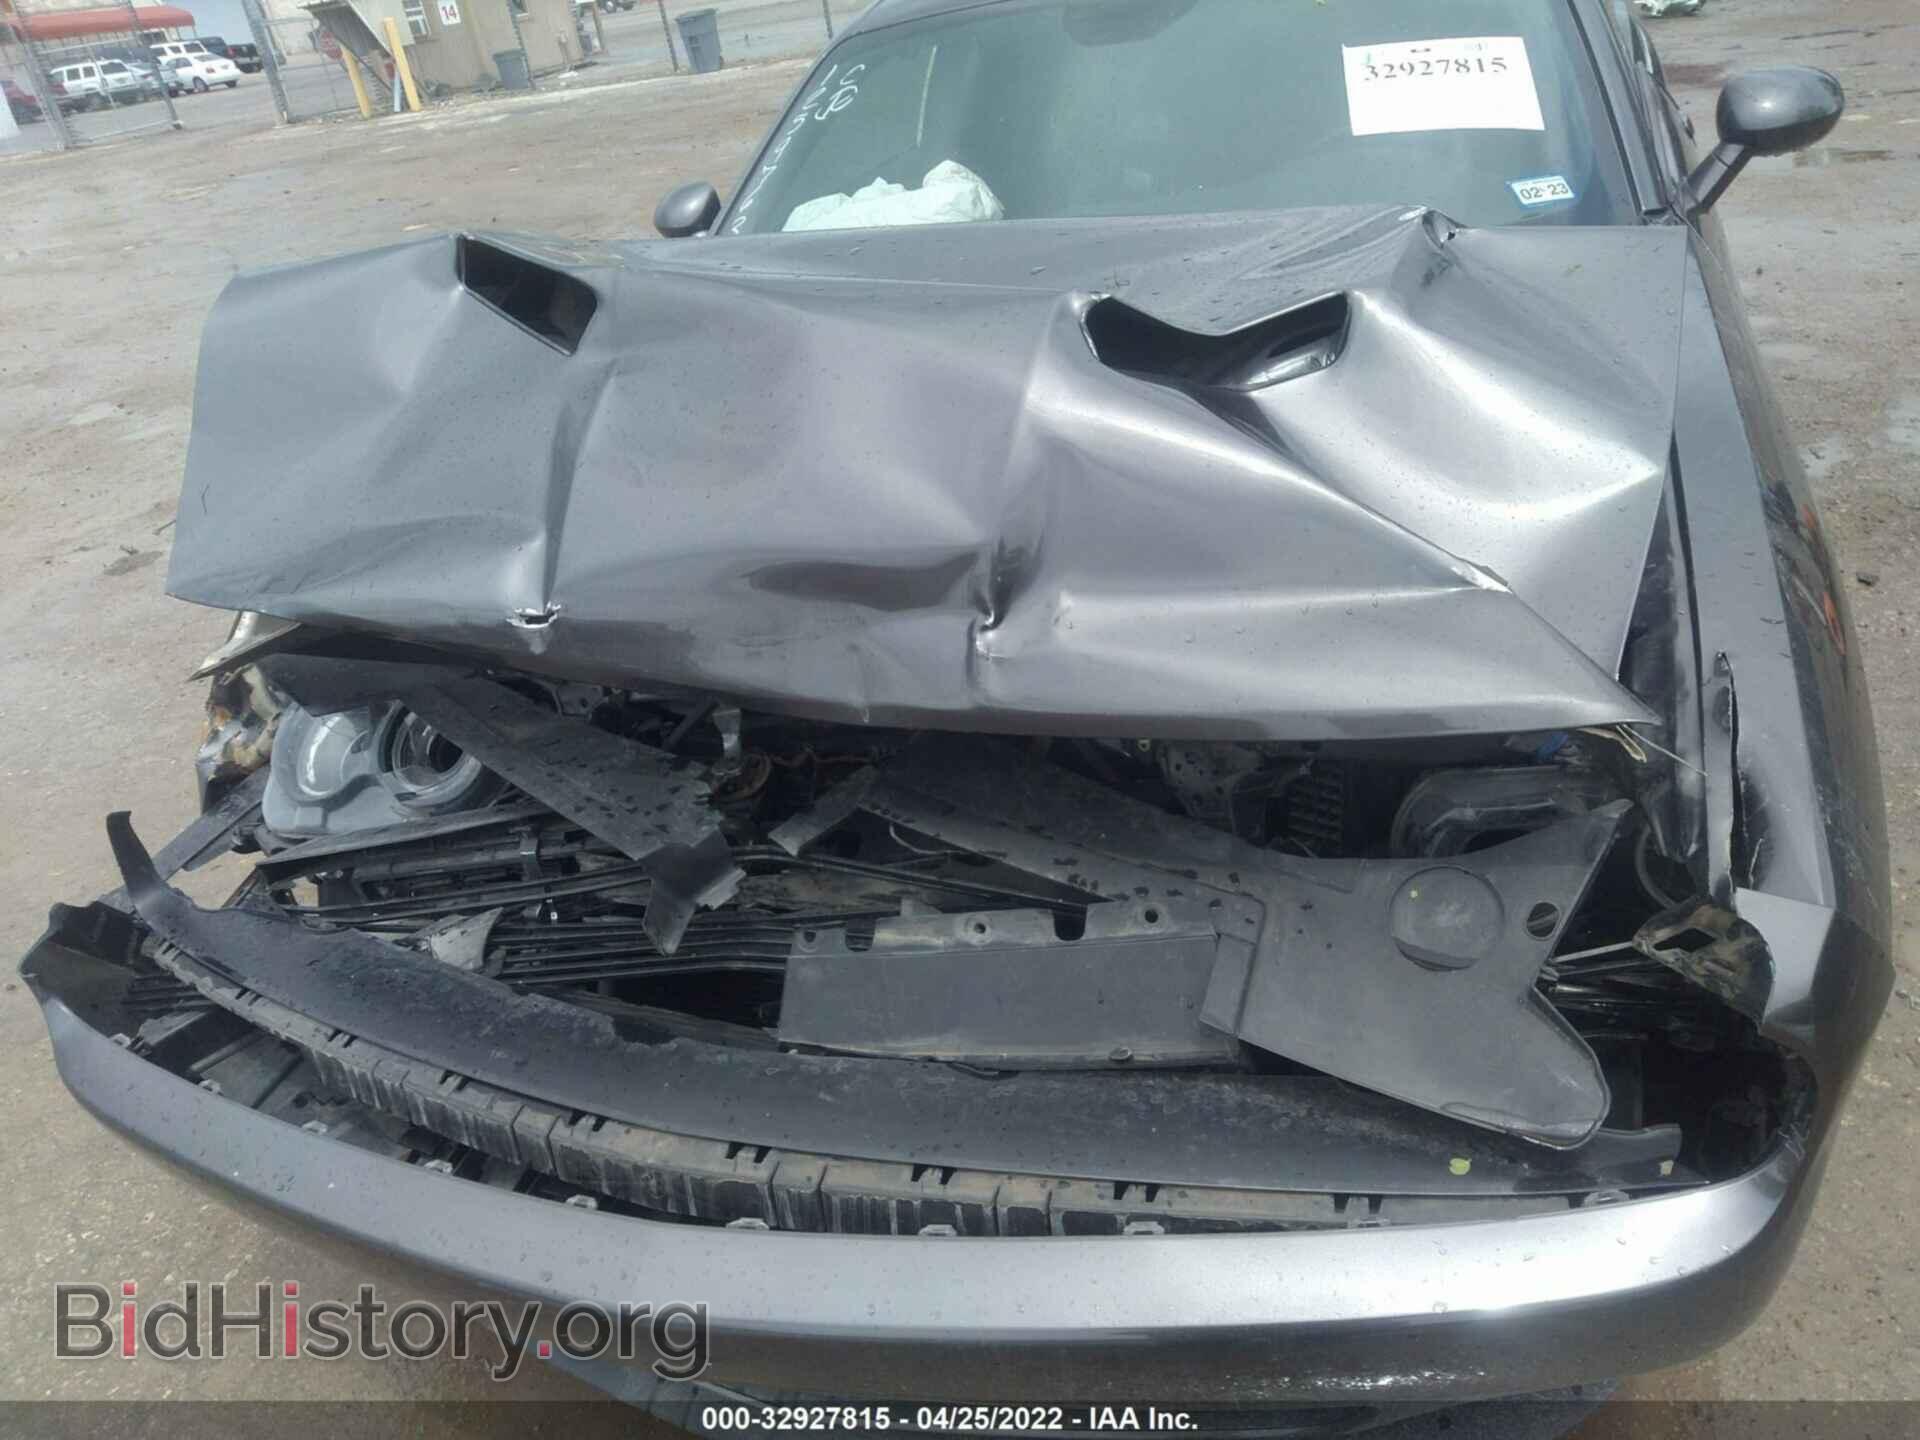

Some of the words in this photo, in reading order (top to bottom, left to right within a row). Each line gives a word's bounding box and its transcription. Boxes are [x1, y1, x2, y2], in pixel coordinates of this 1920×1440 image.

[441, 5, 457, 19] 14
[1364, 56, 1508, 81] 32927815
[1520, 186, 1543, 200] 02
[1547, 183, 1569, 196] 23
